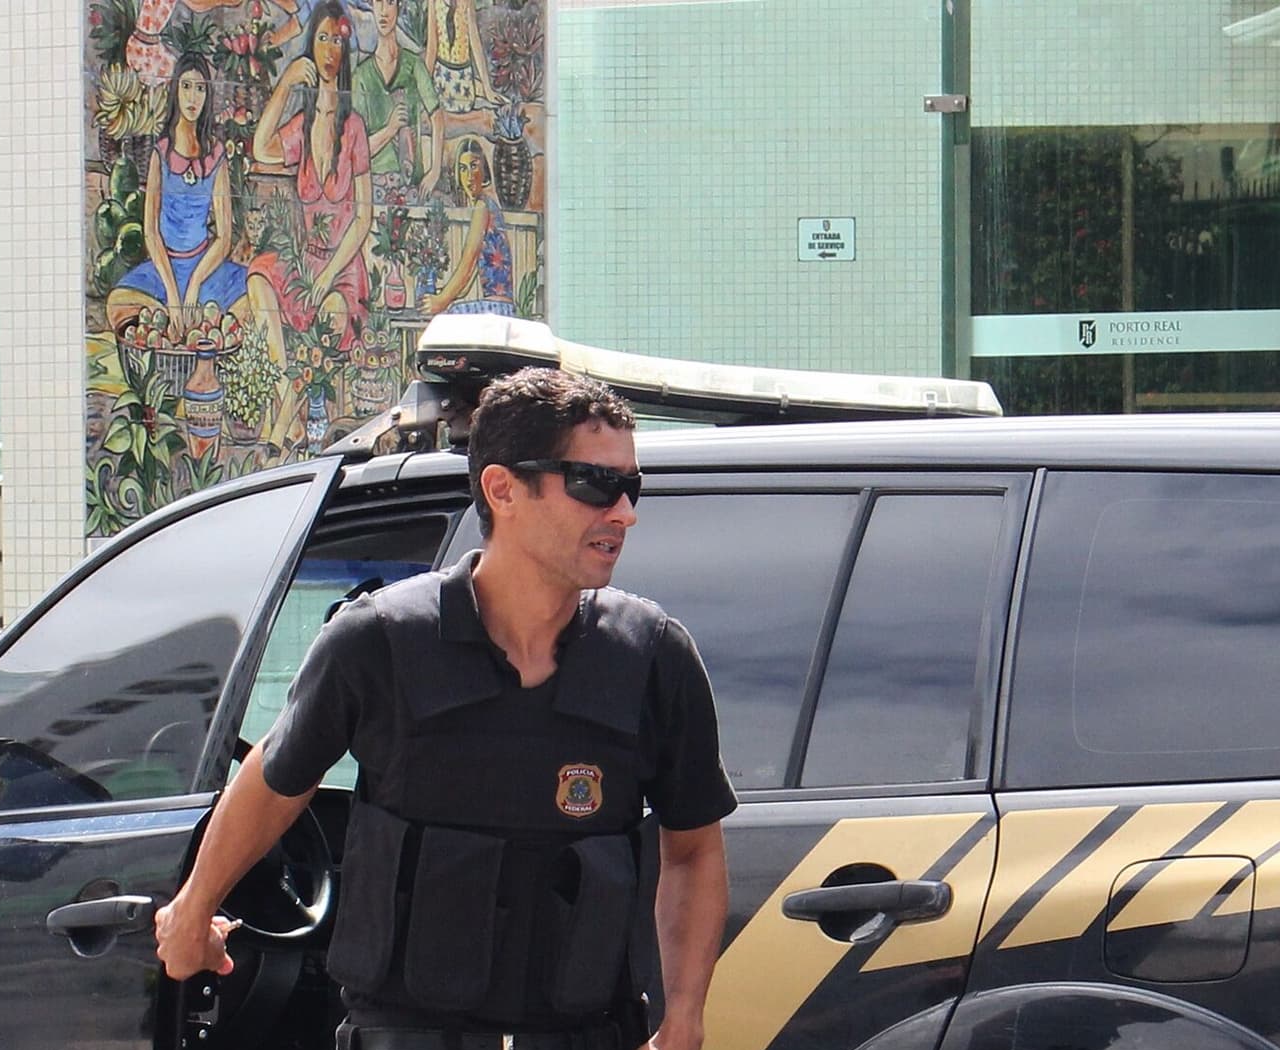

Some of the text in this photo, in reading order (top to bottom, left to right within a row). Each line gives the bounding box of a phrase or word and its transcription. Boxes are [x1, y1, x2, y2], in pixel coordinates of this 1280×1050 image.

[1110, 320, 1183, 332] PORTO REAL
[1112, 336, 1181, 346] RESIDENCE
